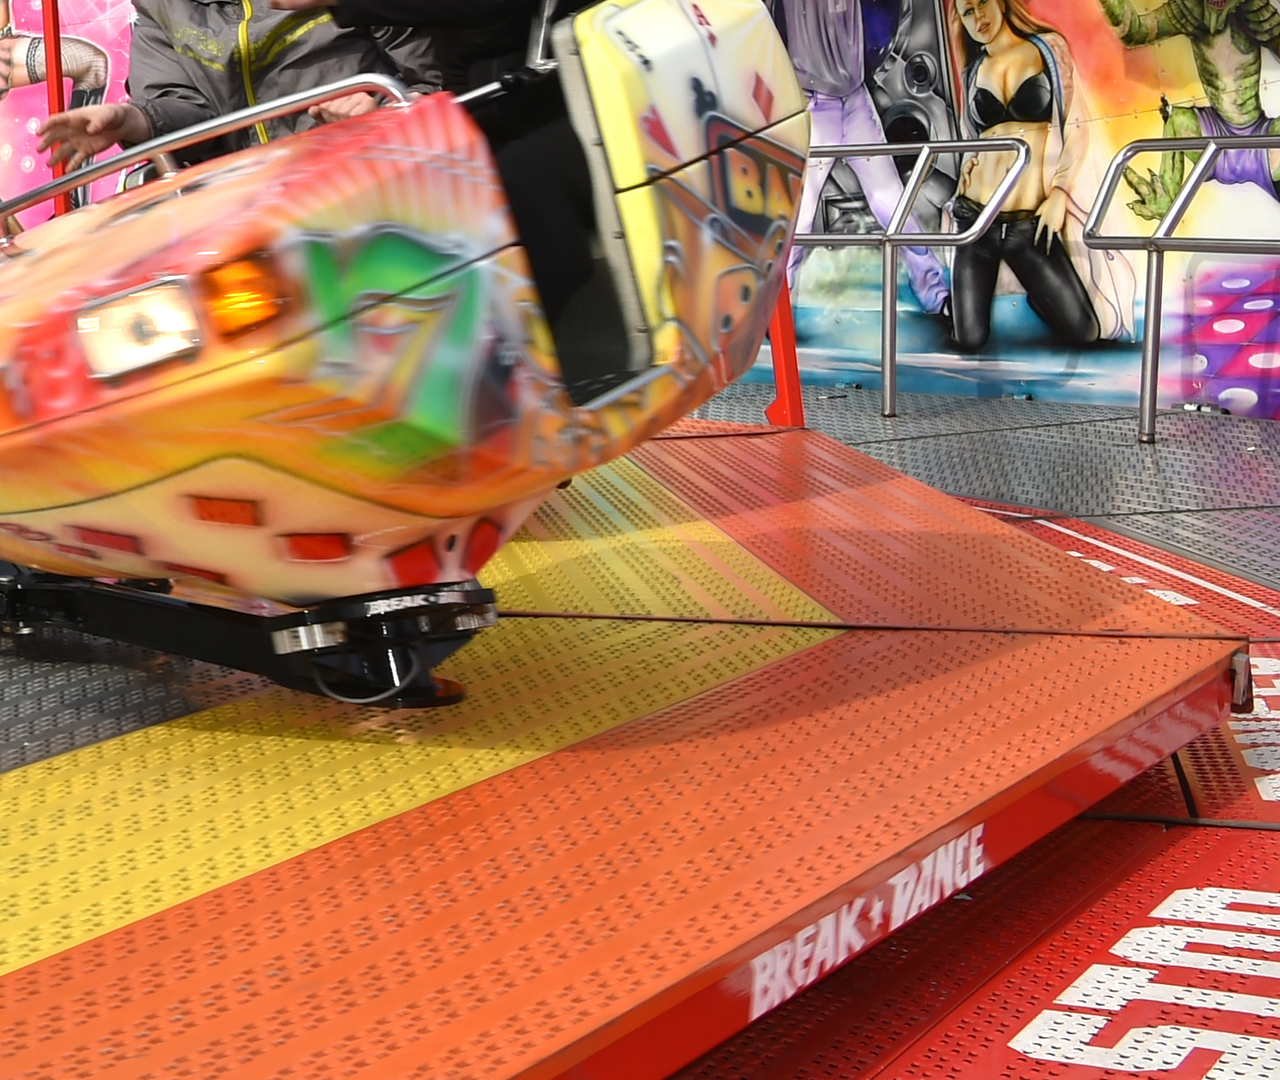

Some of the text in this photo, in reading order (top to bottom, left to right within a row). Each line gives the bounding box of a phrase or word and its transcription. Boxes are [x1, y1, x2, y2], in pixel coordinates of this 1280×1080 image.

[364, 594, 431, 616] BREAK
[748, 822, 986, 1023] BREAK DANCE
